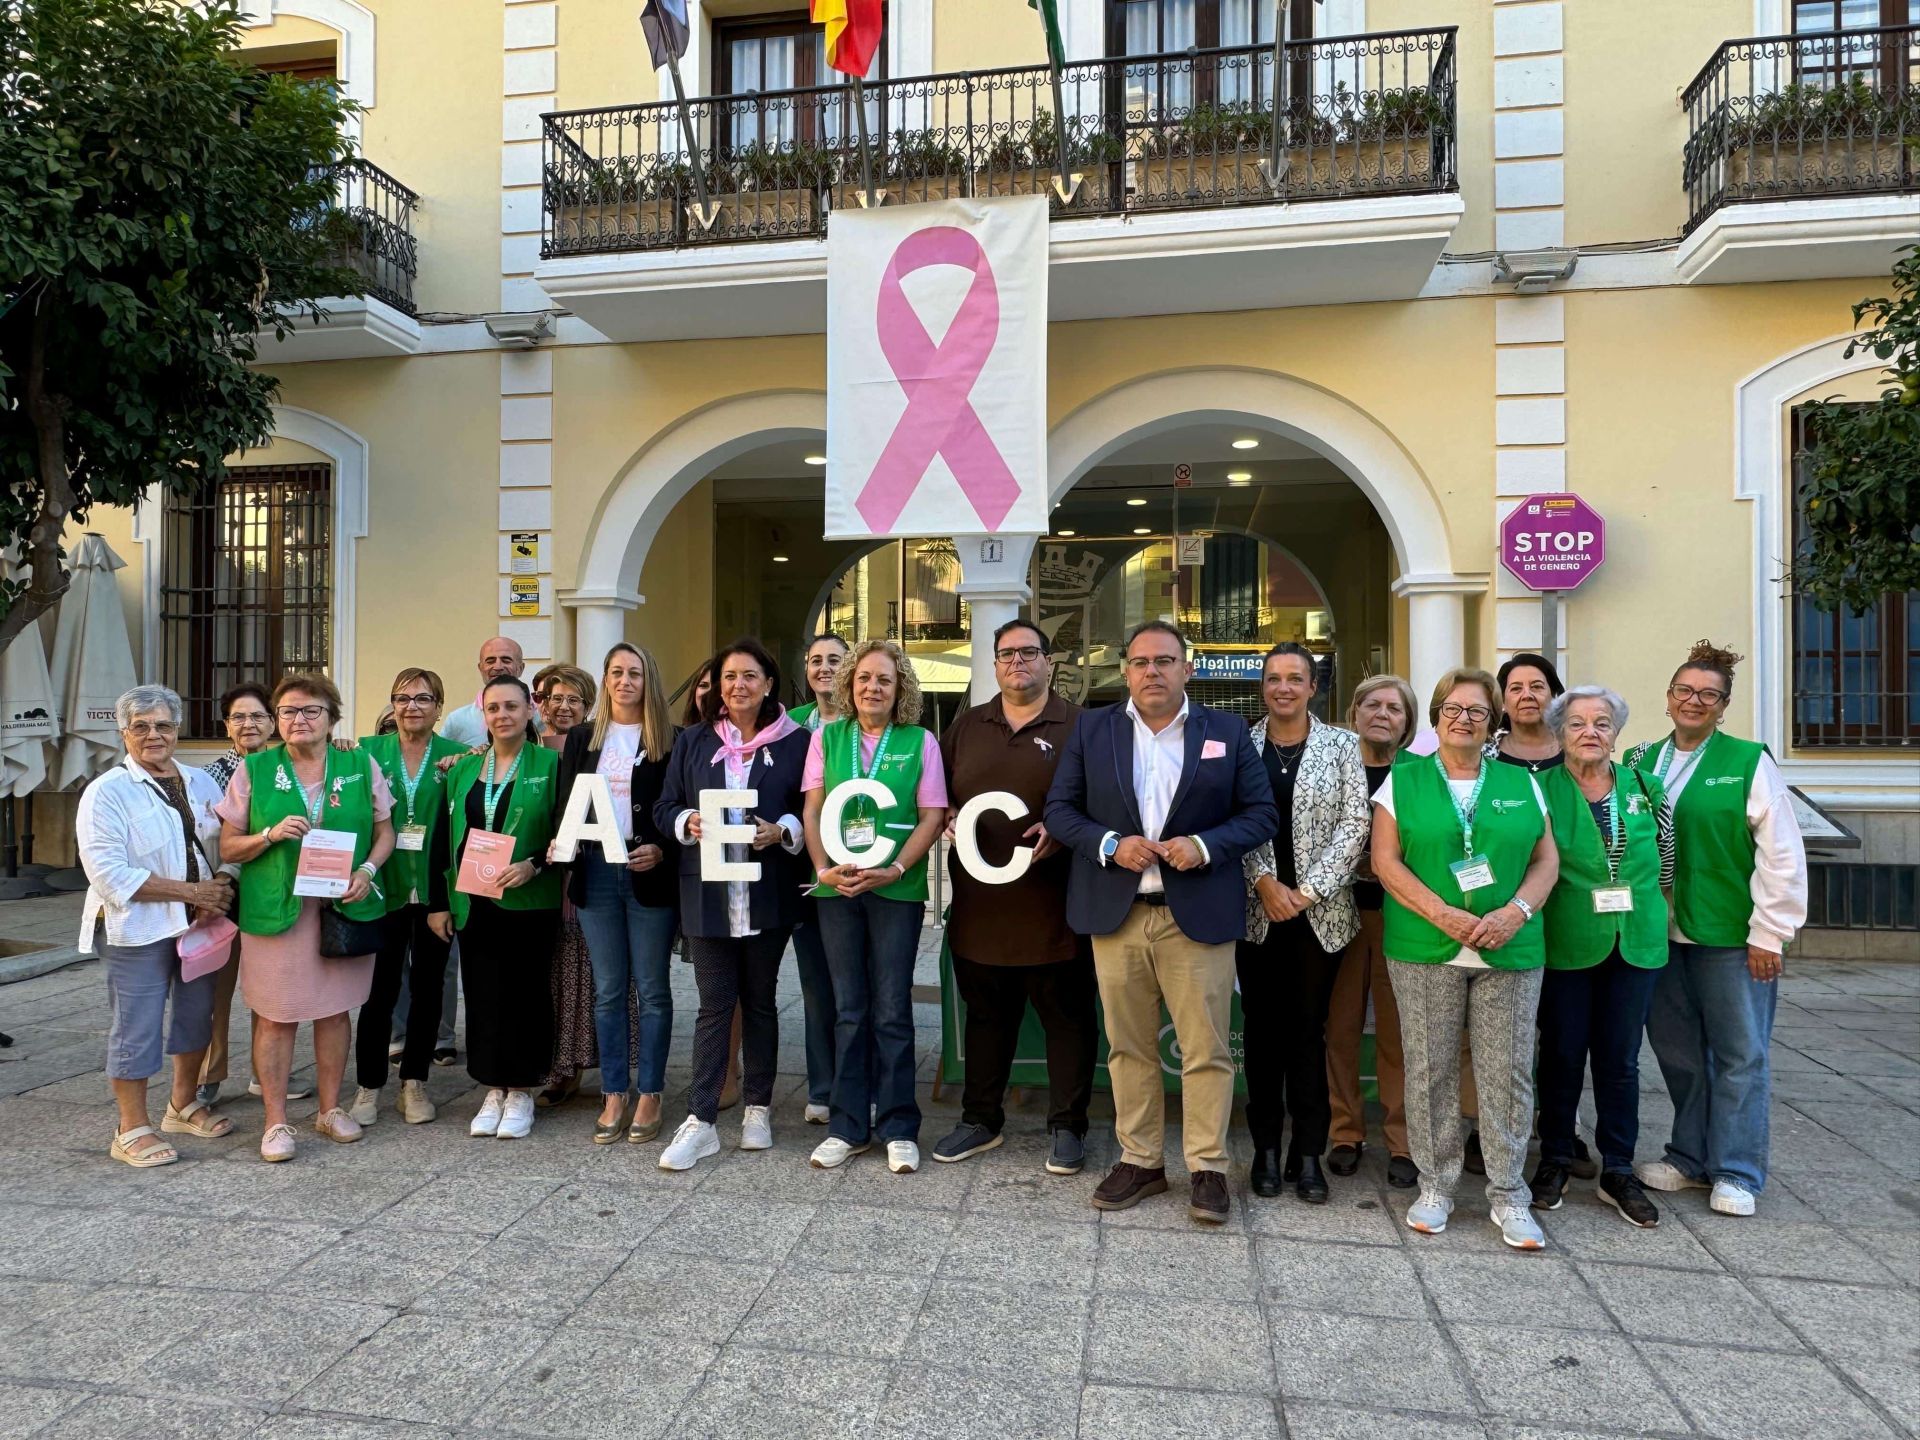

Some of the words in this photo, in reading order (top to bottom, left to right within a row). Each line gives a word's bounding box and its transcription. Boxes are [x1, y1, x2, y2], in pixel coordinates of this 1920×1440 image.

[1514, 531, 1594, 553] STOP
[989, 543, 995, 559] 1
[1538, 553, 1591, 562] VIOLENCIA
[1524, 563, 1537, 571] DE
